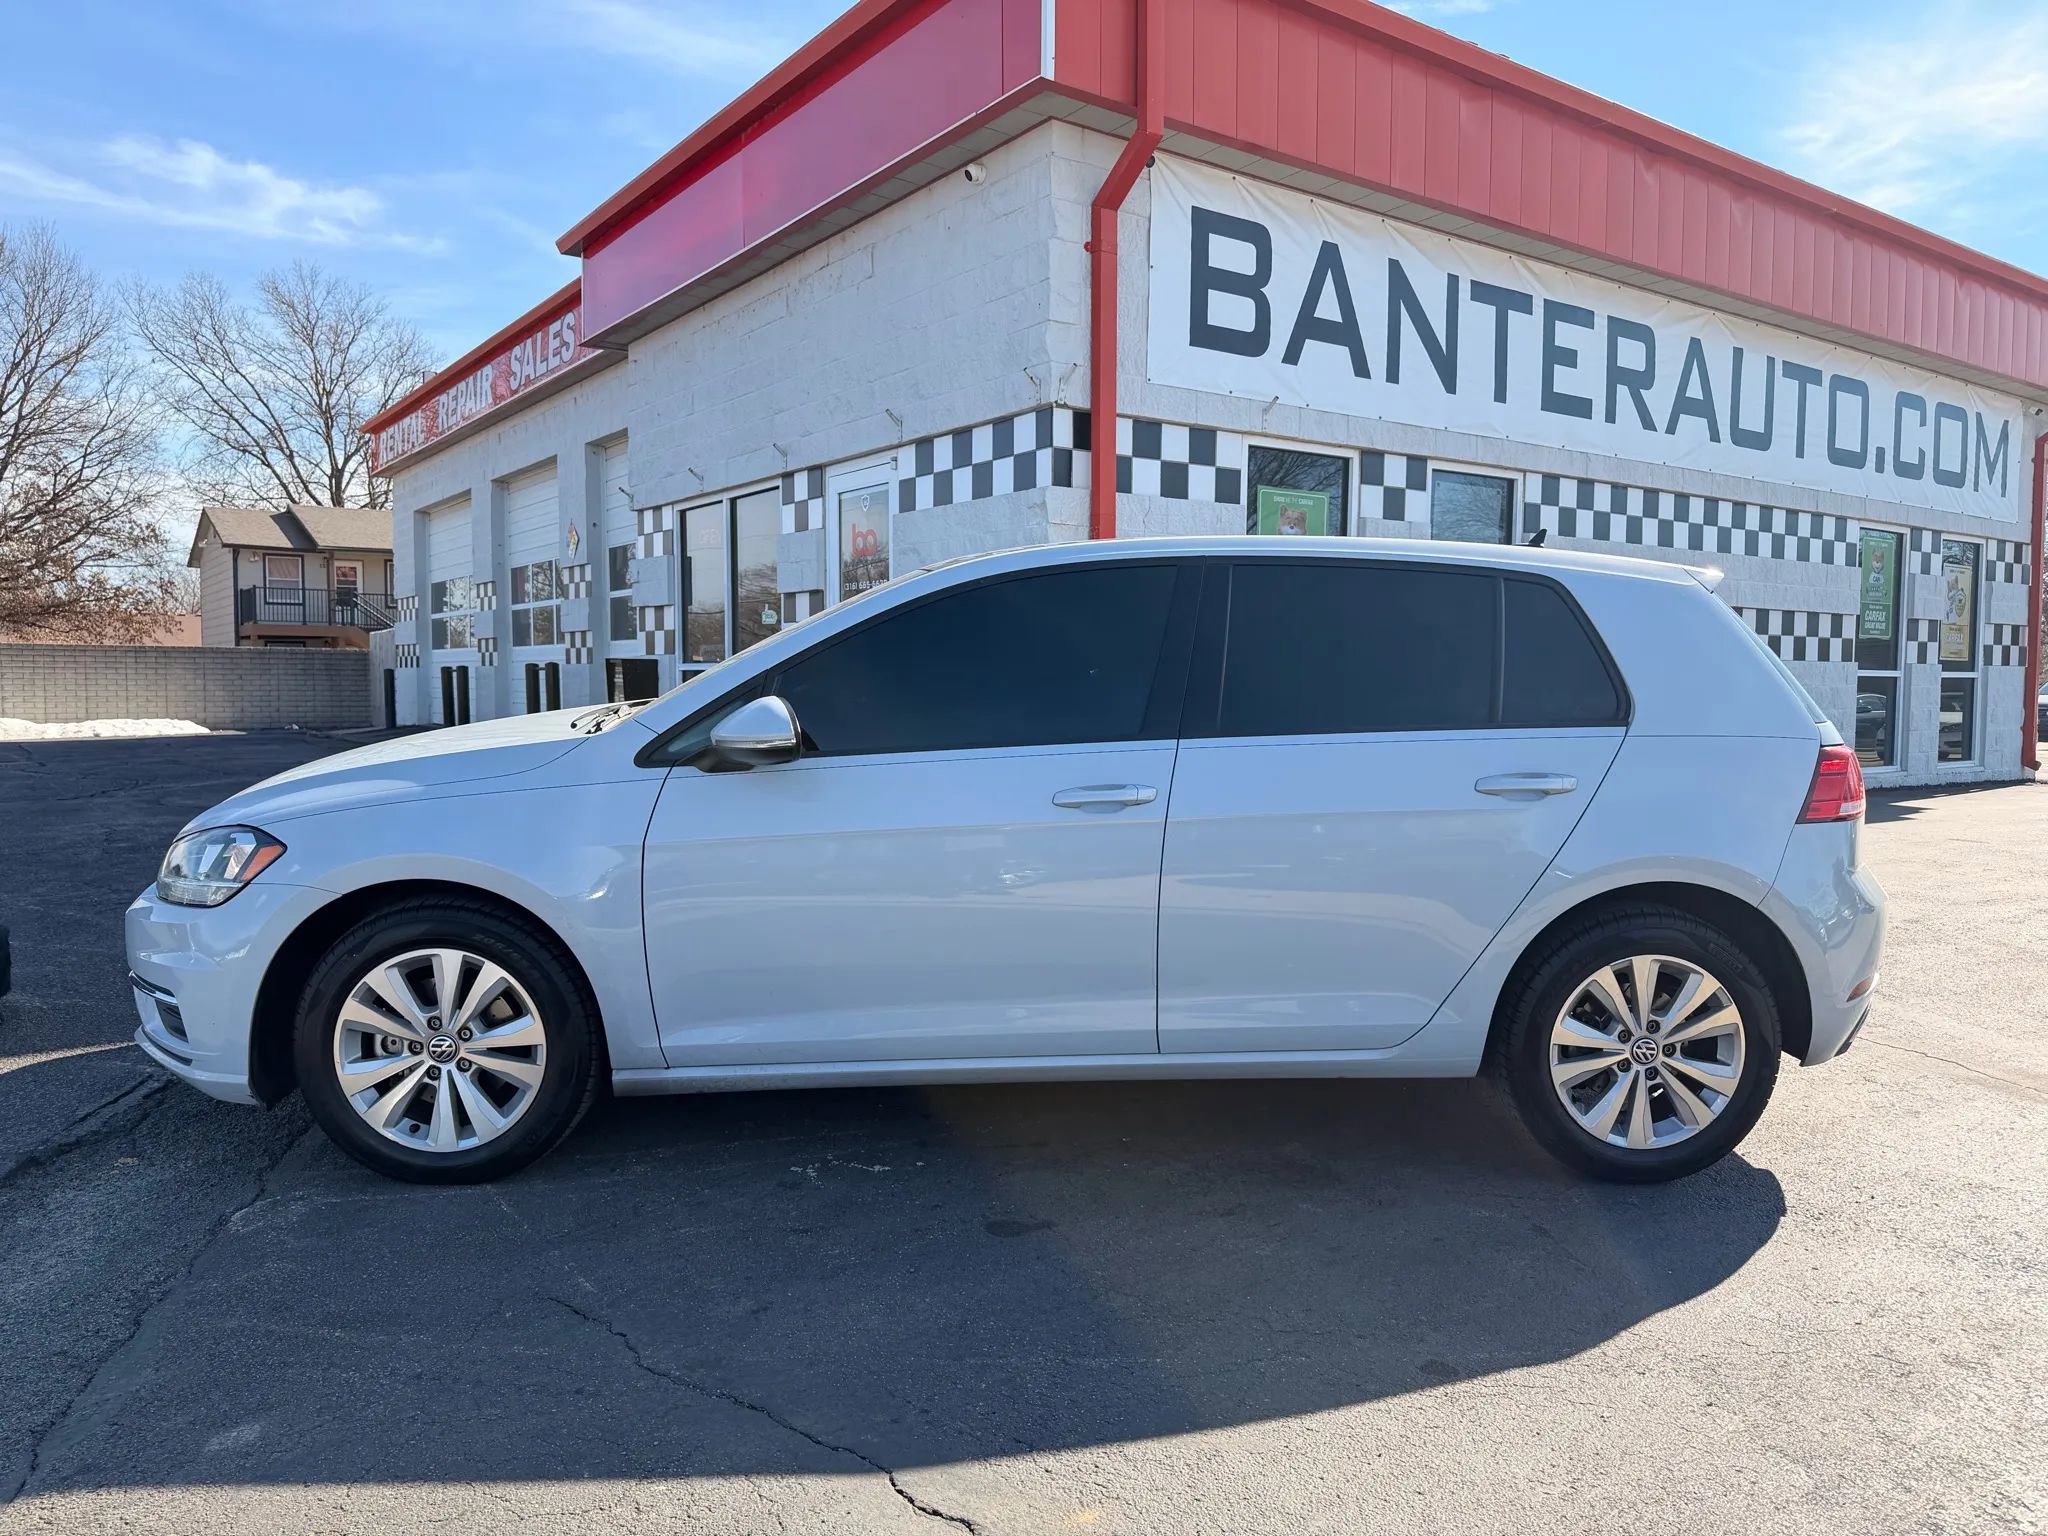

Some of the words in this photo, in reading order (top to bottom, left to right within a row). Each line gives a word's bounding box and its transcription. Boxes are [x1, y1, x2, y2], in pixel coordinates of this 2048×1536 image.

[379, 409, 425, 466] RENTAL
[437, 364, 494, 431] REPAIR
[509, 311, 576, 391] SALES
[1189, 205, 2009, 498] BANTERAUTO.COM
